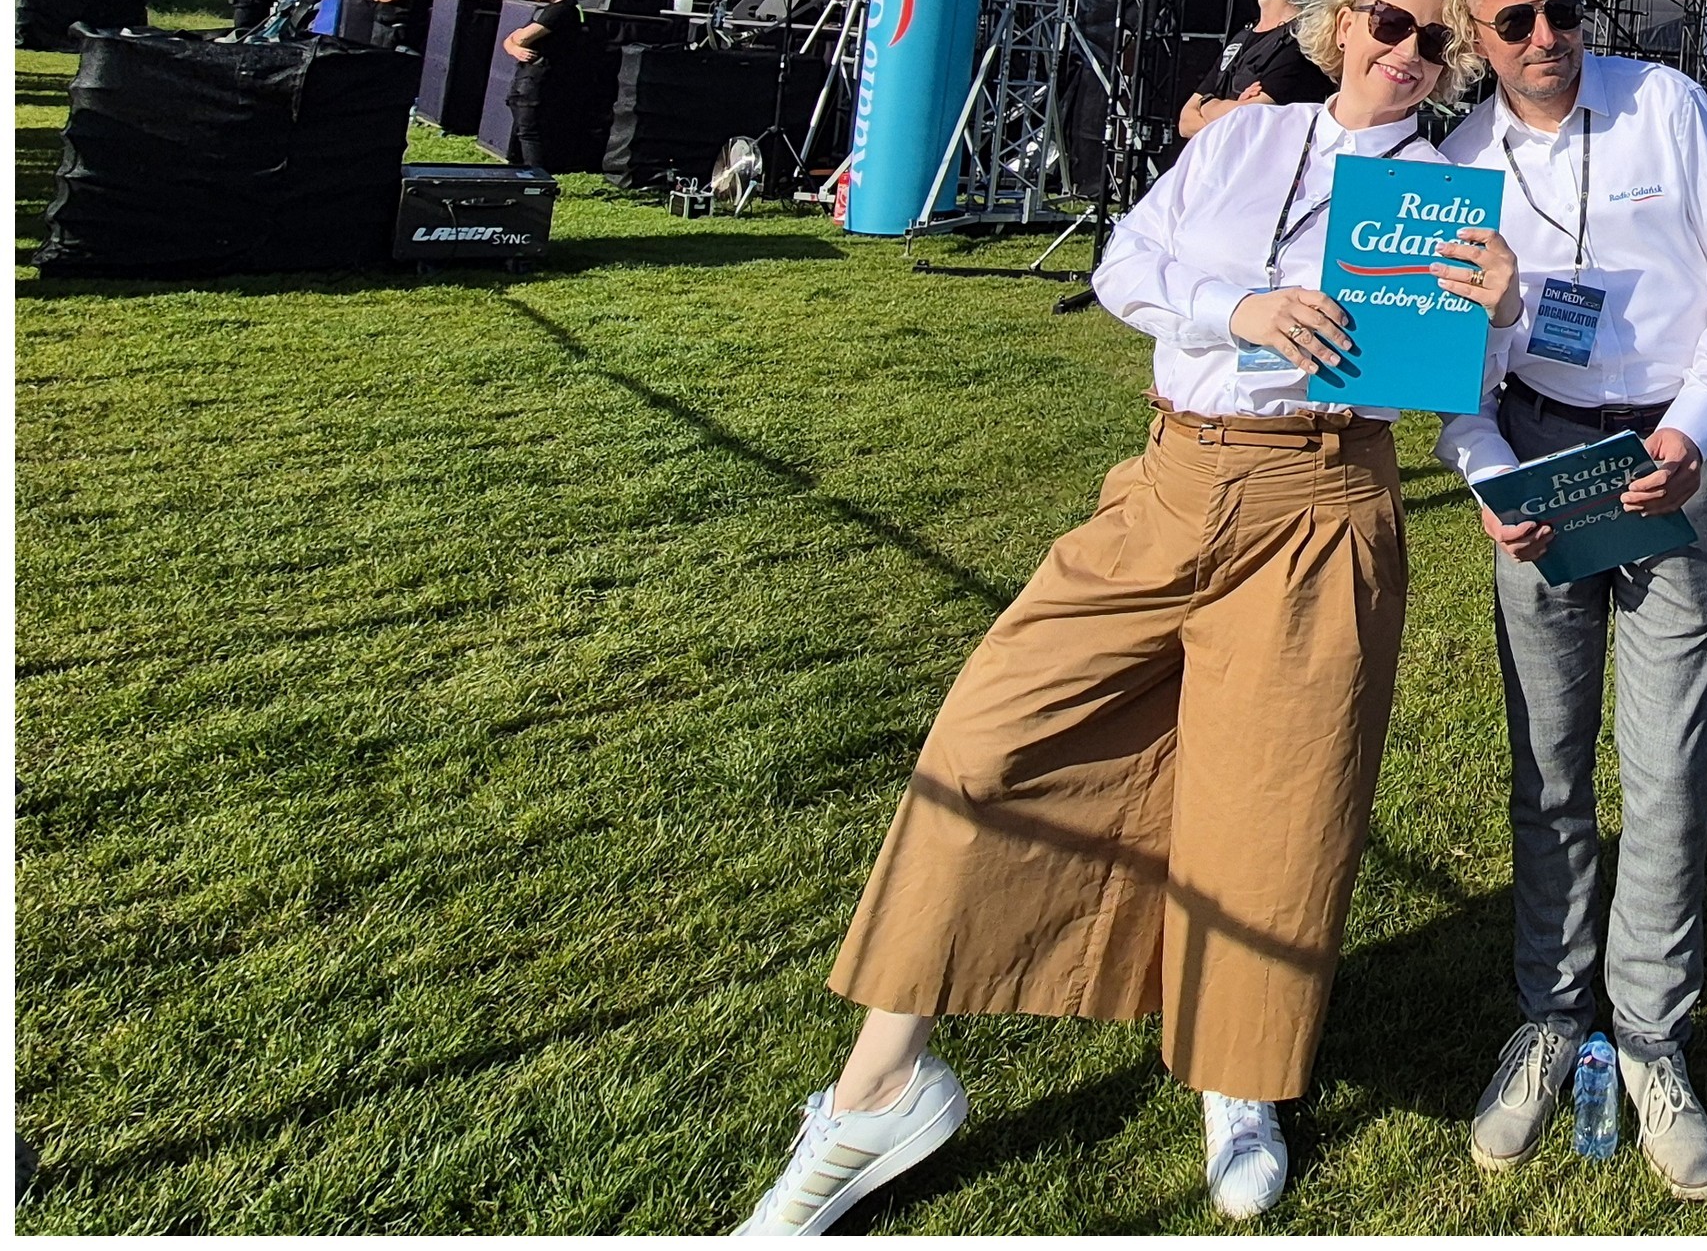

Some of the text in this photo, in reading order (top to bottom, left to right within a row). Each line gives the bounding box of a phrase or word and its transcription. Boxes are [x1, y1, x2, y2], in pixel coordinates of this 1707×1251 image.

[1609, 184, 1663, 202] Radio Gdańsk
[1397, 193, 1486, 225] Radio
[492, 233, 531, 244] SYNC
[1337, 288, 1367, 303] na
[1370, 286, 1435, 315] dobrej
[1545, 288, 1560, 299] DNI
[1562, 293, 1585, 305] REDY
[1538, 304, 1598, 329] ORGANIZATOR
[1551, 455, 1633, 490] Radio
[1520, 469, 1638, 515] Gdańsk
[1564, 506, 1622, 532] dobrej
